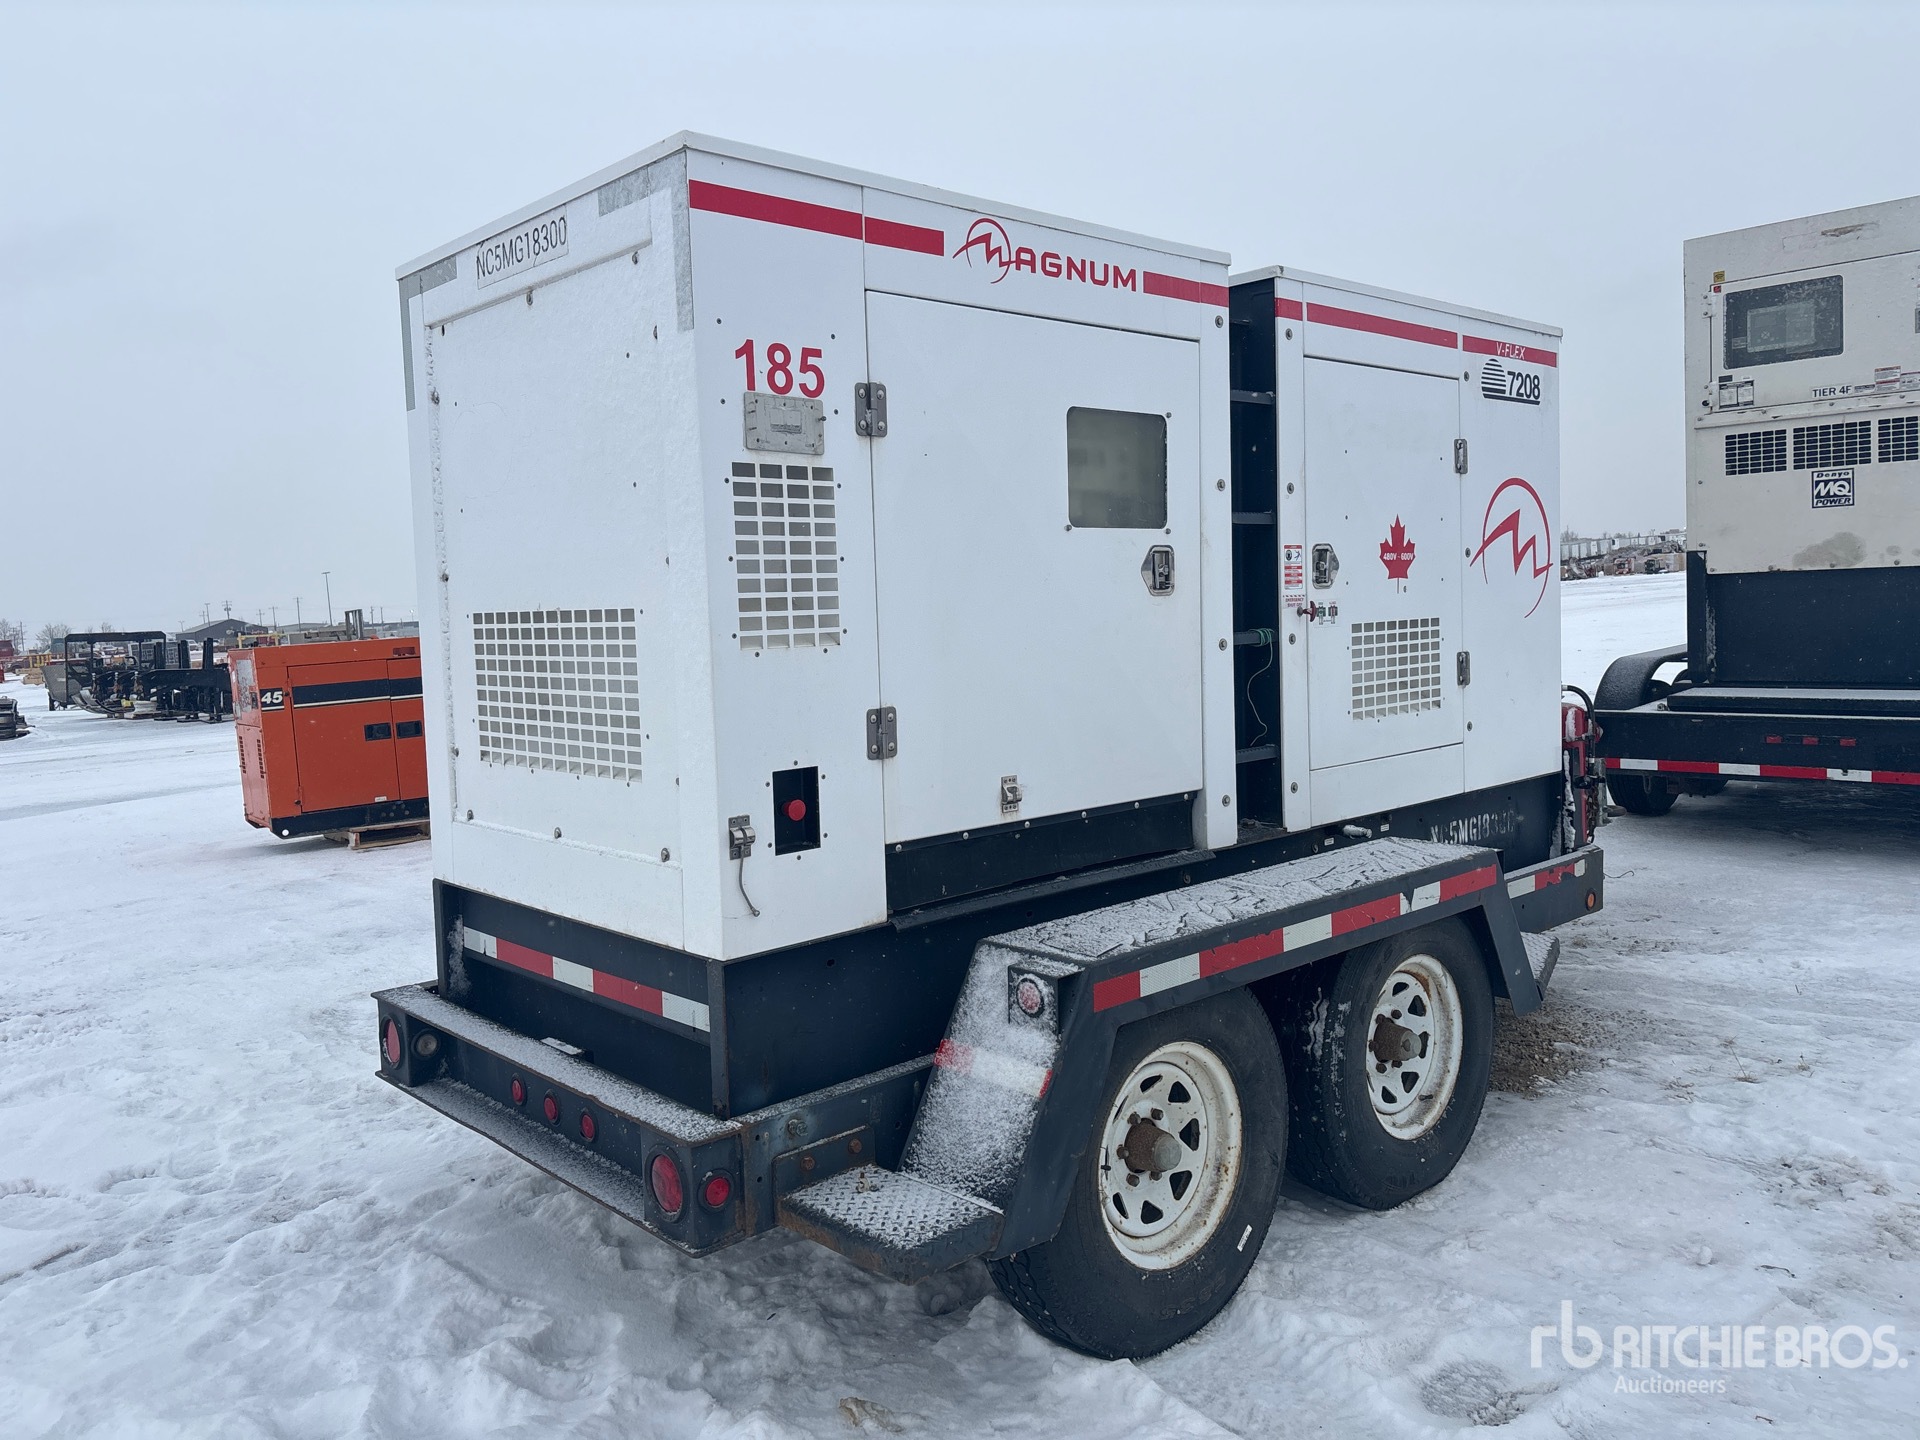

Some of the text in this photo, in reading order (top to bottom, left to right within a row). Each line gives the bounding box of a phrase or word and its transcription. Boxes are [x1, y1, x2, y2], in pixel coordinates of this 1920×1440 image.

[476, 216, 567, 280] NC5MG18300
[952, 218, 1137, 292] MAGNUM
[1496, 342, 1526, 360] V-FLEX
[735, 339, 825, 398] 185
[1507, 371, 1541, 400] 7208
[1812, 387, 1837, 398] TIER
[1838, 385, 1852, 394] 4F
[1816, 471, 1850, 479] Denyo
[1815, 480, 1851, 497] MQ
[1815, 497, 1851, 506] POWER
[261, 691, 283, 704] 45
